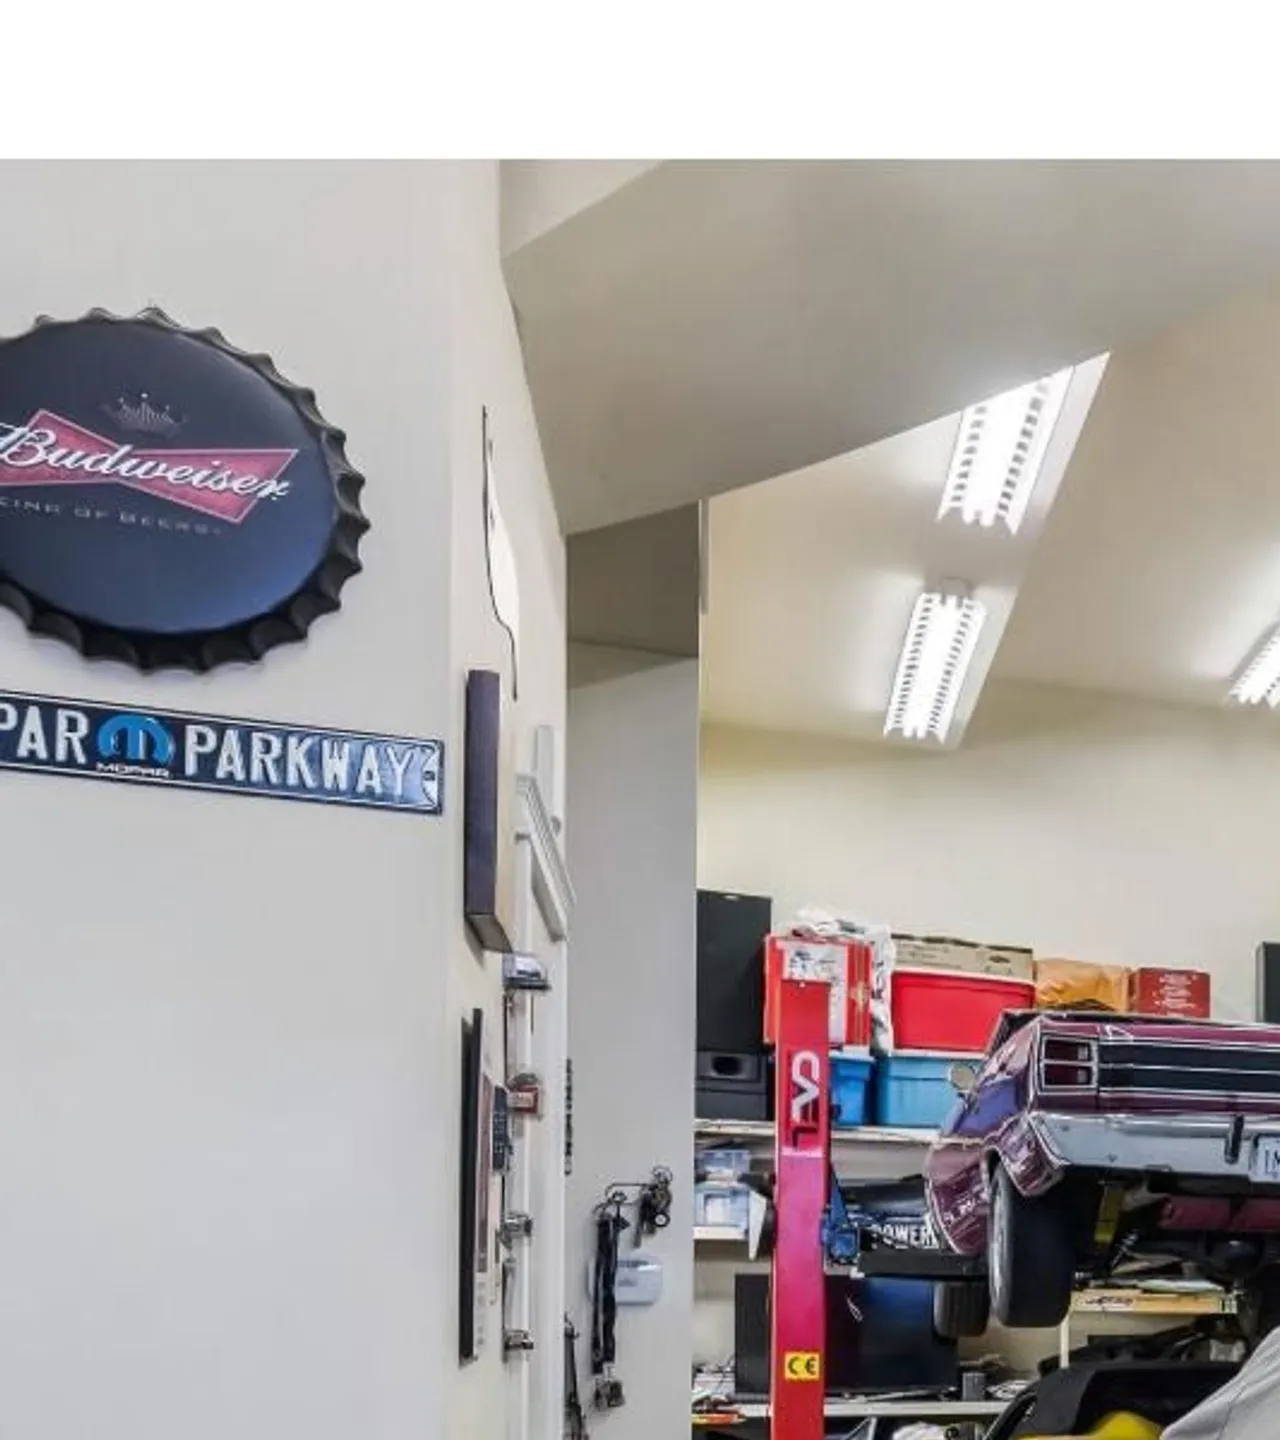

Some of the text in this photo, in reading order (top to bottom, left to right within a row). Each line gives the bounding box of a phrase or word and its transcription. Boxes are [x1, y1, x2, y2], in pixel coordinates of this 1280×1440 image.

[0, 422, 290, 500] Budweiser
[96, 762, 170, 778] MOPAR
[184, 724, 414, 797] PARKWAY
[788, 1356, 816, 1376] CE
